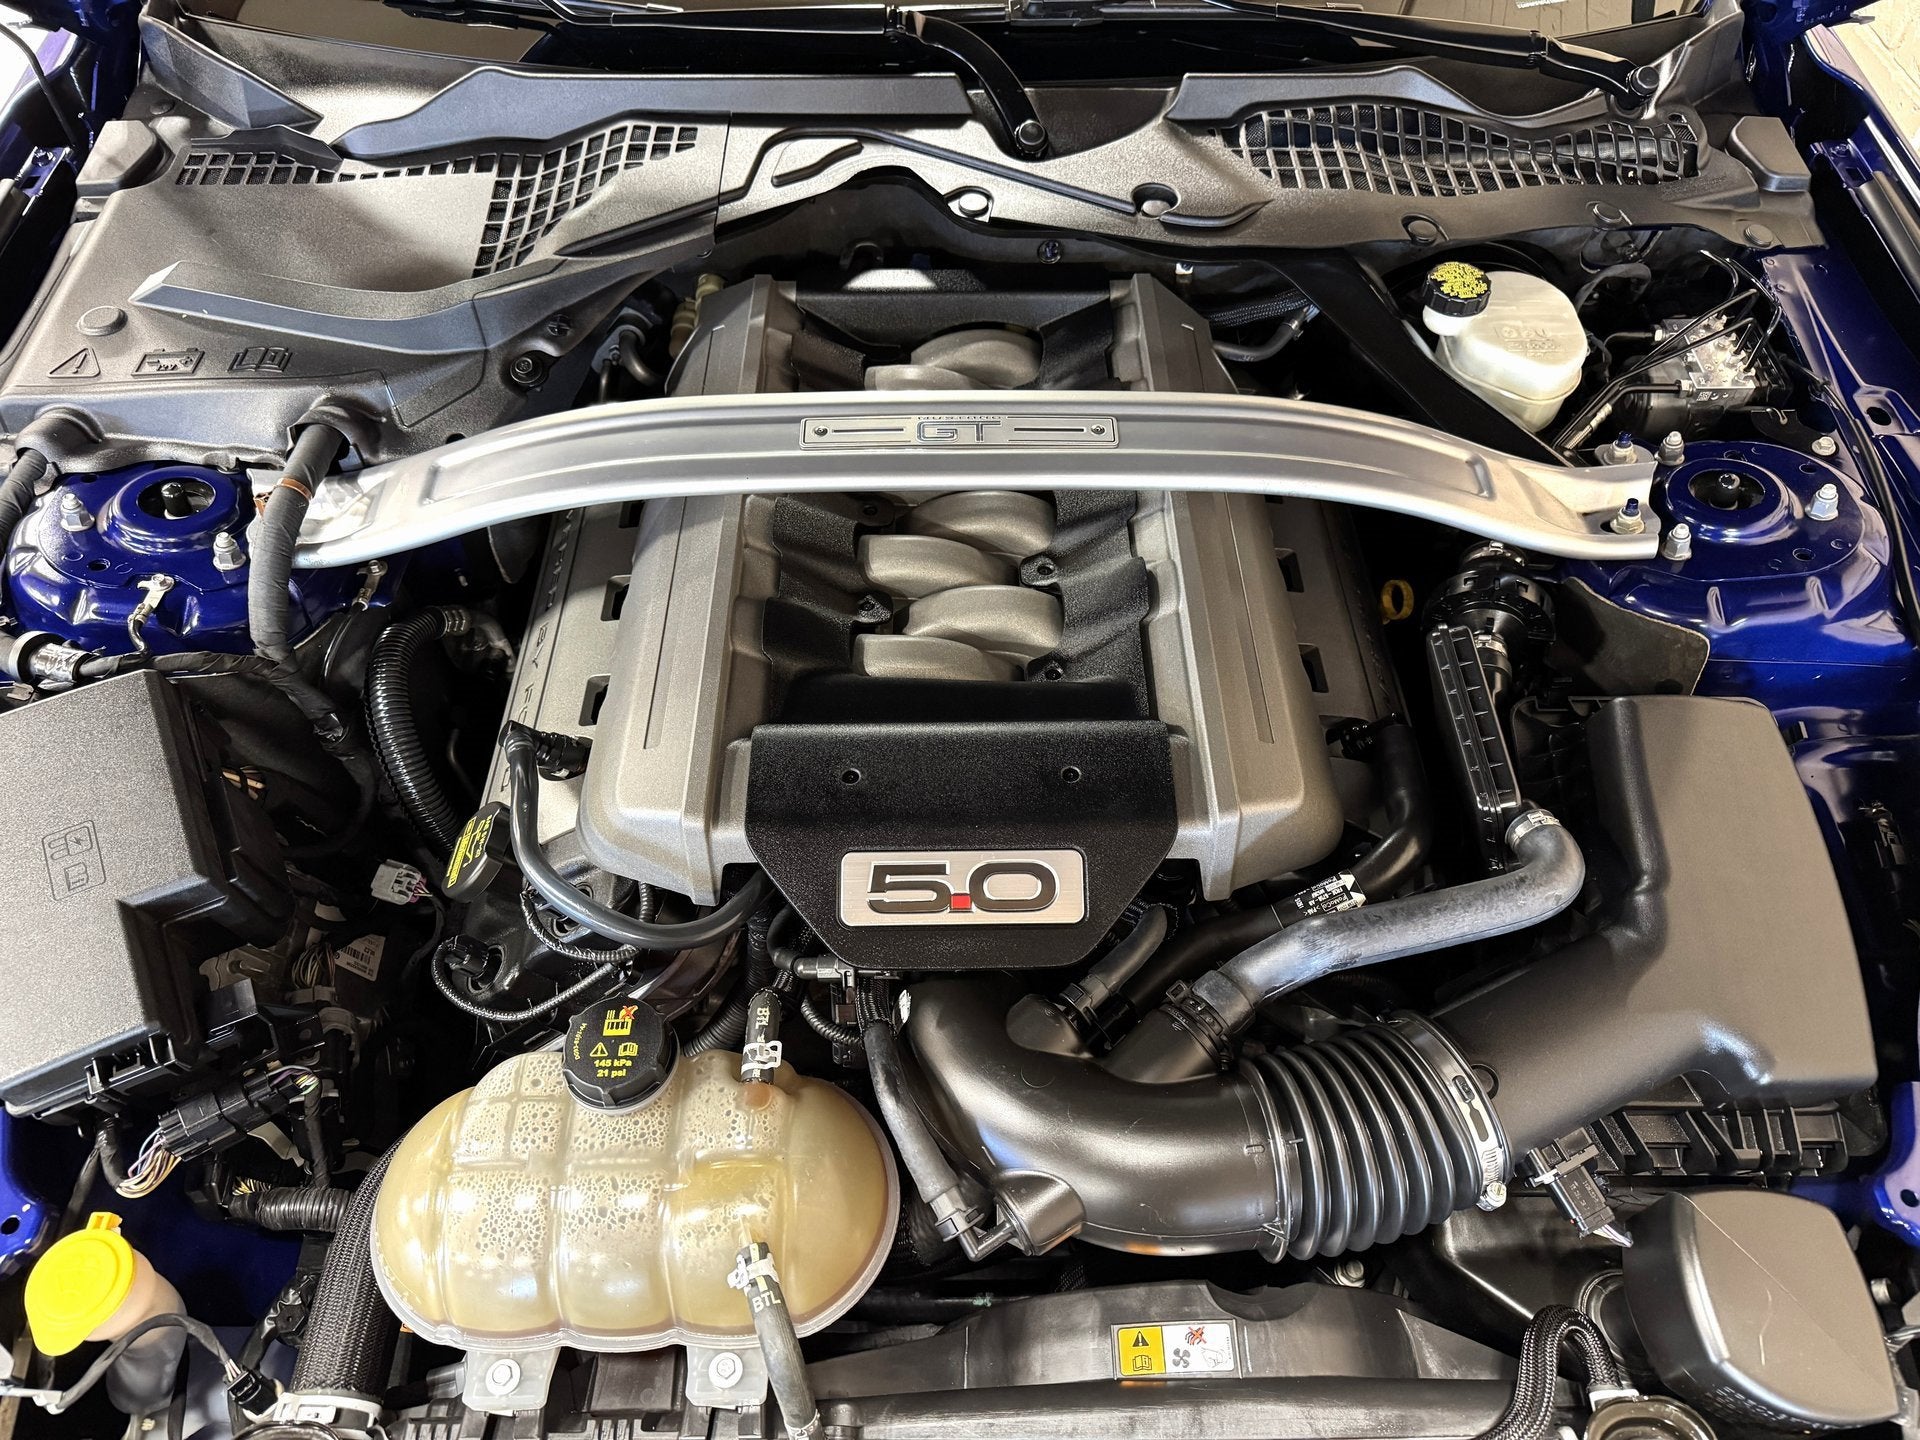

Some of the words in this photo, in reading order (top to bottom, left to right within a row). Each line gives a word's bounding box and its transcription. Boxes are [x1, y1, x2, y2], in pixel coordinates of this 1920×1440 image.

[916, 420, 1002, 443] GT
[867, 859, 1061, 914] 5.0
[594, 1059, 612, 1067] 145
[613, 1059, 632, 1067] kPa
[596, 1069, 609, 1077] 21
[611, 1069, 627, 1078] psi
[751, 1290, 782, 1314] BTL
